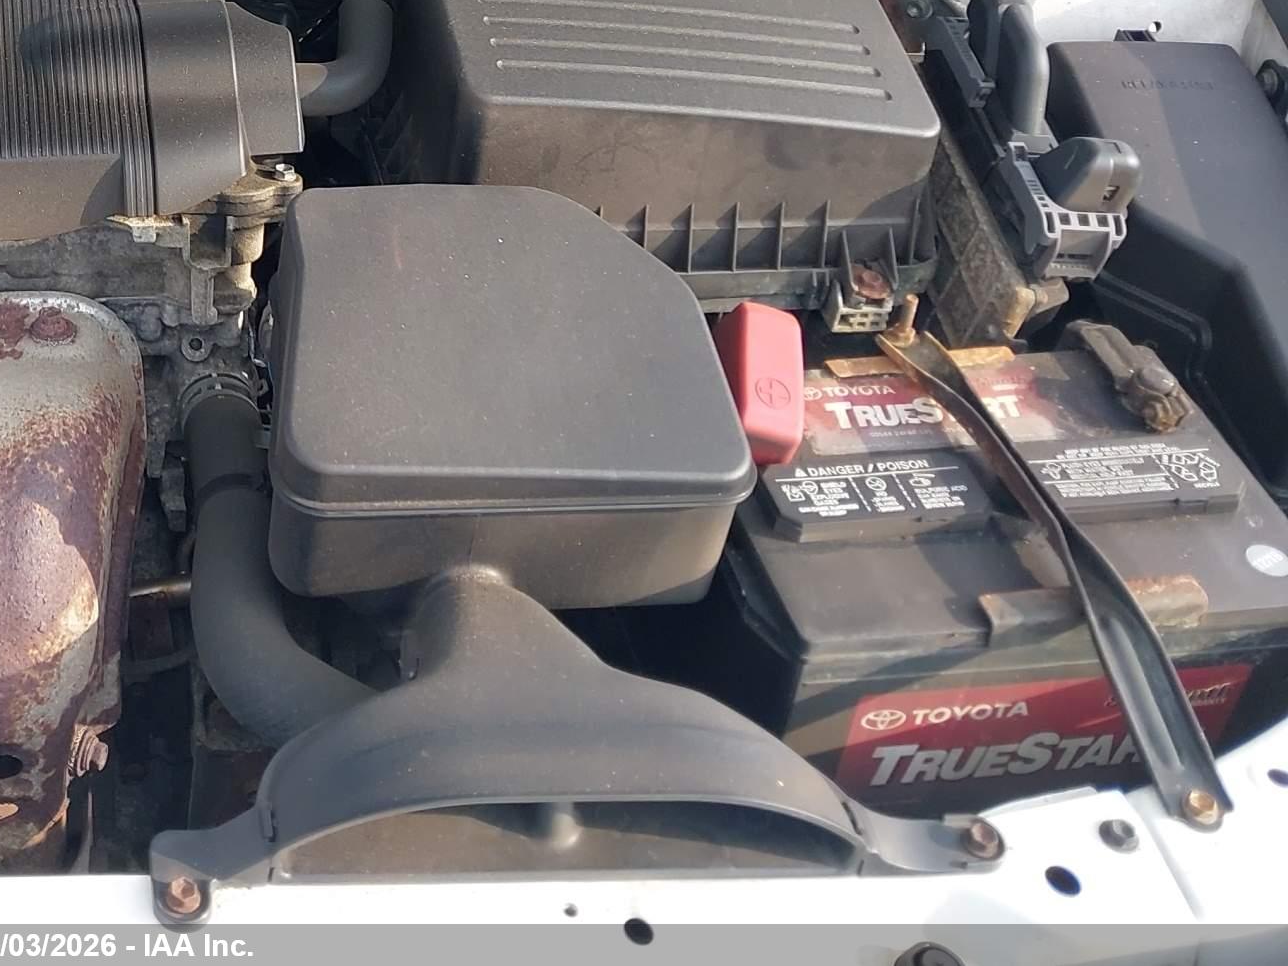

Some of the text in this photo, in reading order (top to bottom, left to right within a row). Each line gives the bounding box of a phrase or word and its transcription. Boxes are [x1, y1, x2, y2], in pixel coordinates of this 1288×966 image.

[823, 385, 896, 397] TOYOTA
[807, 465, 865, 477] DANGER
[878, 459, 930, 472] POISON
[913, 701, 1029, 726] TOYOTA
